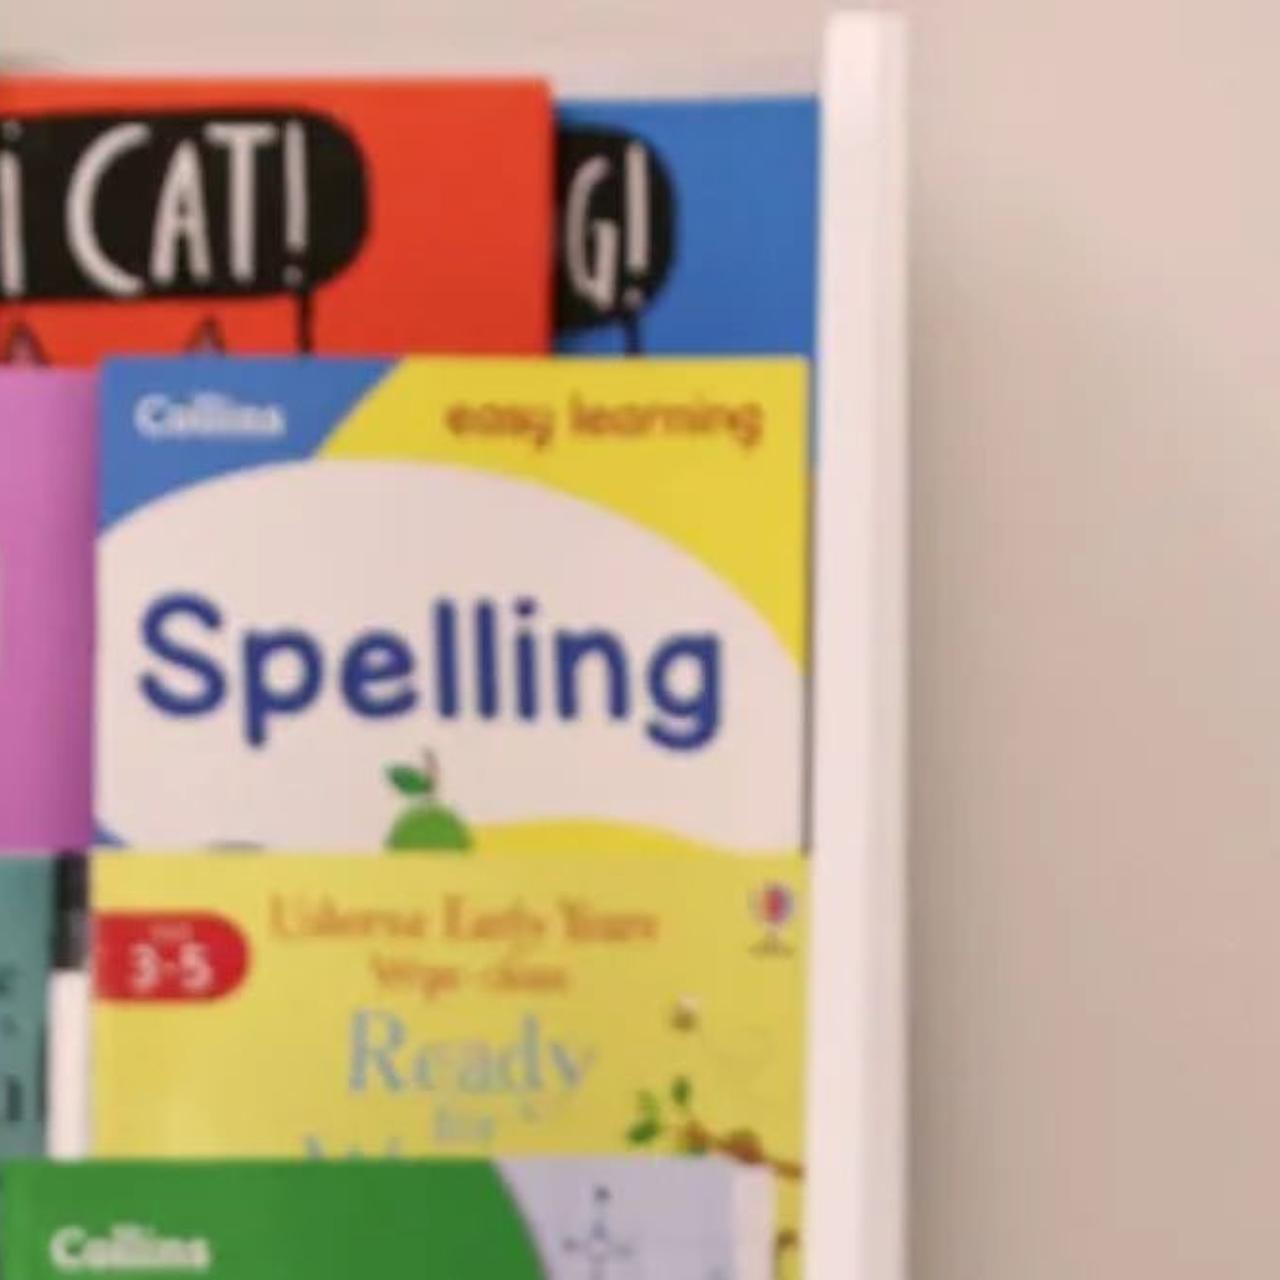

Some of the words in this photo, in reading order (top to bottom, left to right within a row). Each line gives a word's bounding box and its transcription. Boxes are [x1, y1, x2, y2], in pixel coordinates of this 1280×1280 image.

[65, 121, 307, 296] CAT!
[132, 392, 285, 437] Collins
[444, 402, 554, 451] easy
[568, 390, 764, 453] learning
[138, 592, 723, 752] Spelling
[347, 1008, 600, 1125] Ready
[49, 1226, 210, 1270] Collins
